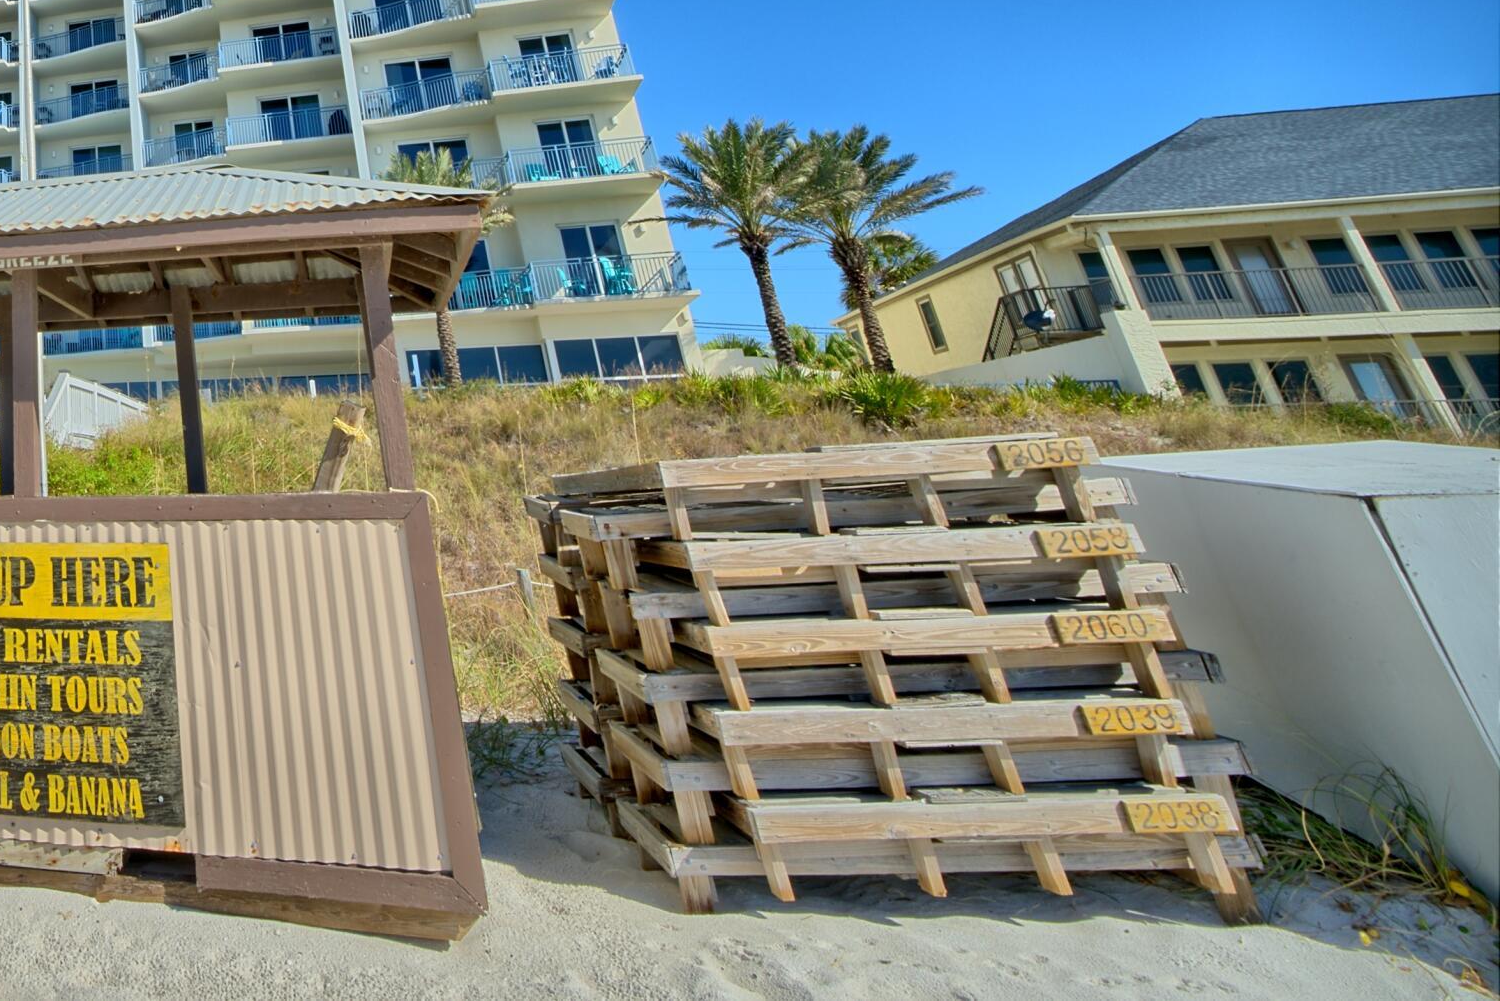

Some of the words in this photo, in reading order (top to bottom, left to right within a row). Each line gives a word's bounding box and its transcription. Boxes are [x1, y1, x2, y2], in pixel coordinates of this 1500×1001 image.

[1007, 440, 1084, 467] 2056
[1051, 527, 1129, 554] 2058
[50, 556, 156, 608] HERE
[1065, 613, 1148, 641] 2060
[3, 627, 142, 666] RENTALS
[46, 675, 144, 715] TOURS
[1095, 704, 1177, 732] 2039
[42, 724, 130, 765] BOATS
[20, 771, 40, 811] &
[47, 773, 145, 819] BANANA
[1135, 801, 1220, 830] 2038
